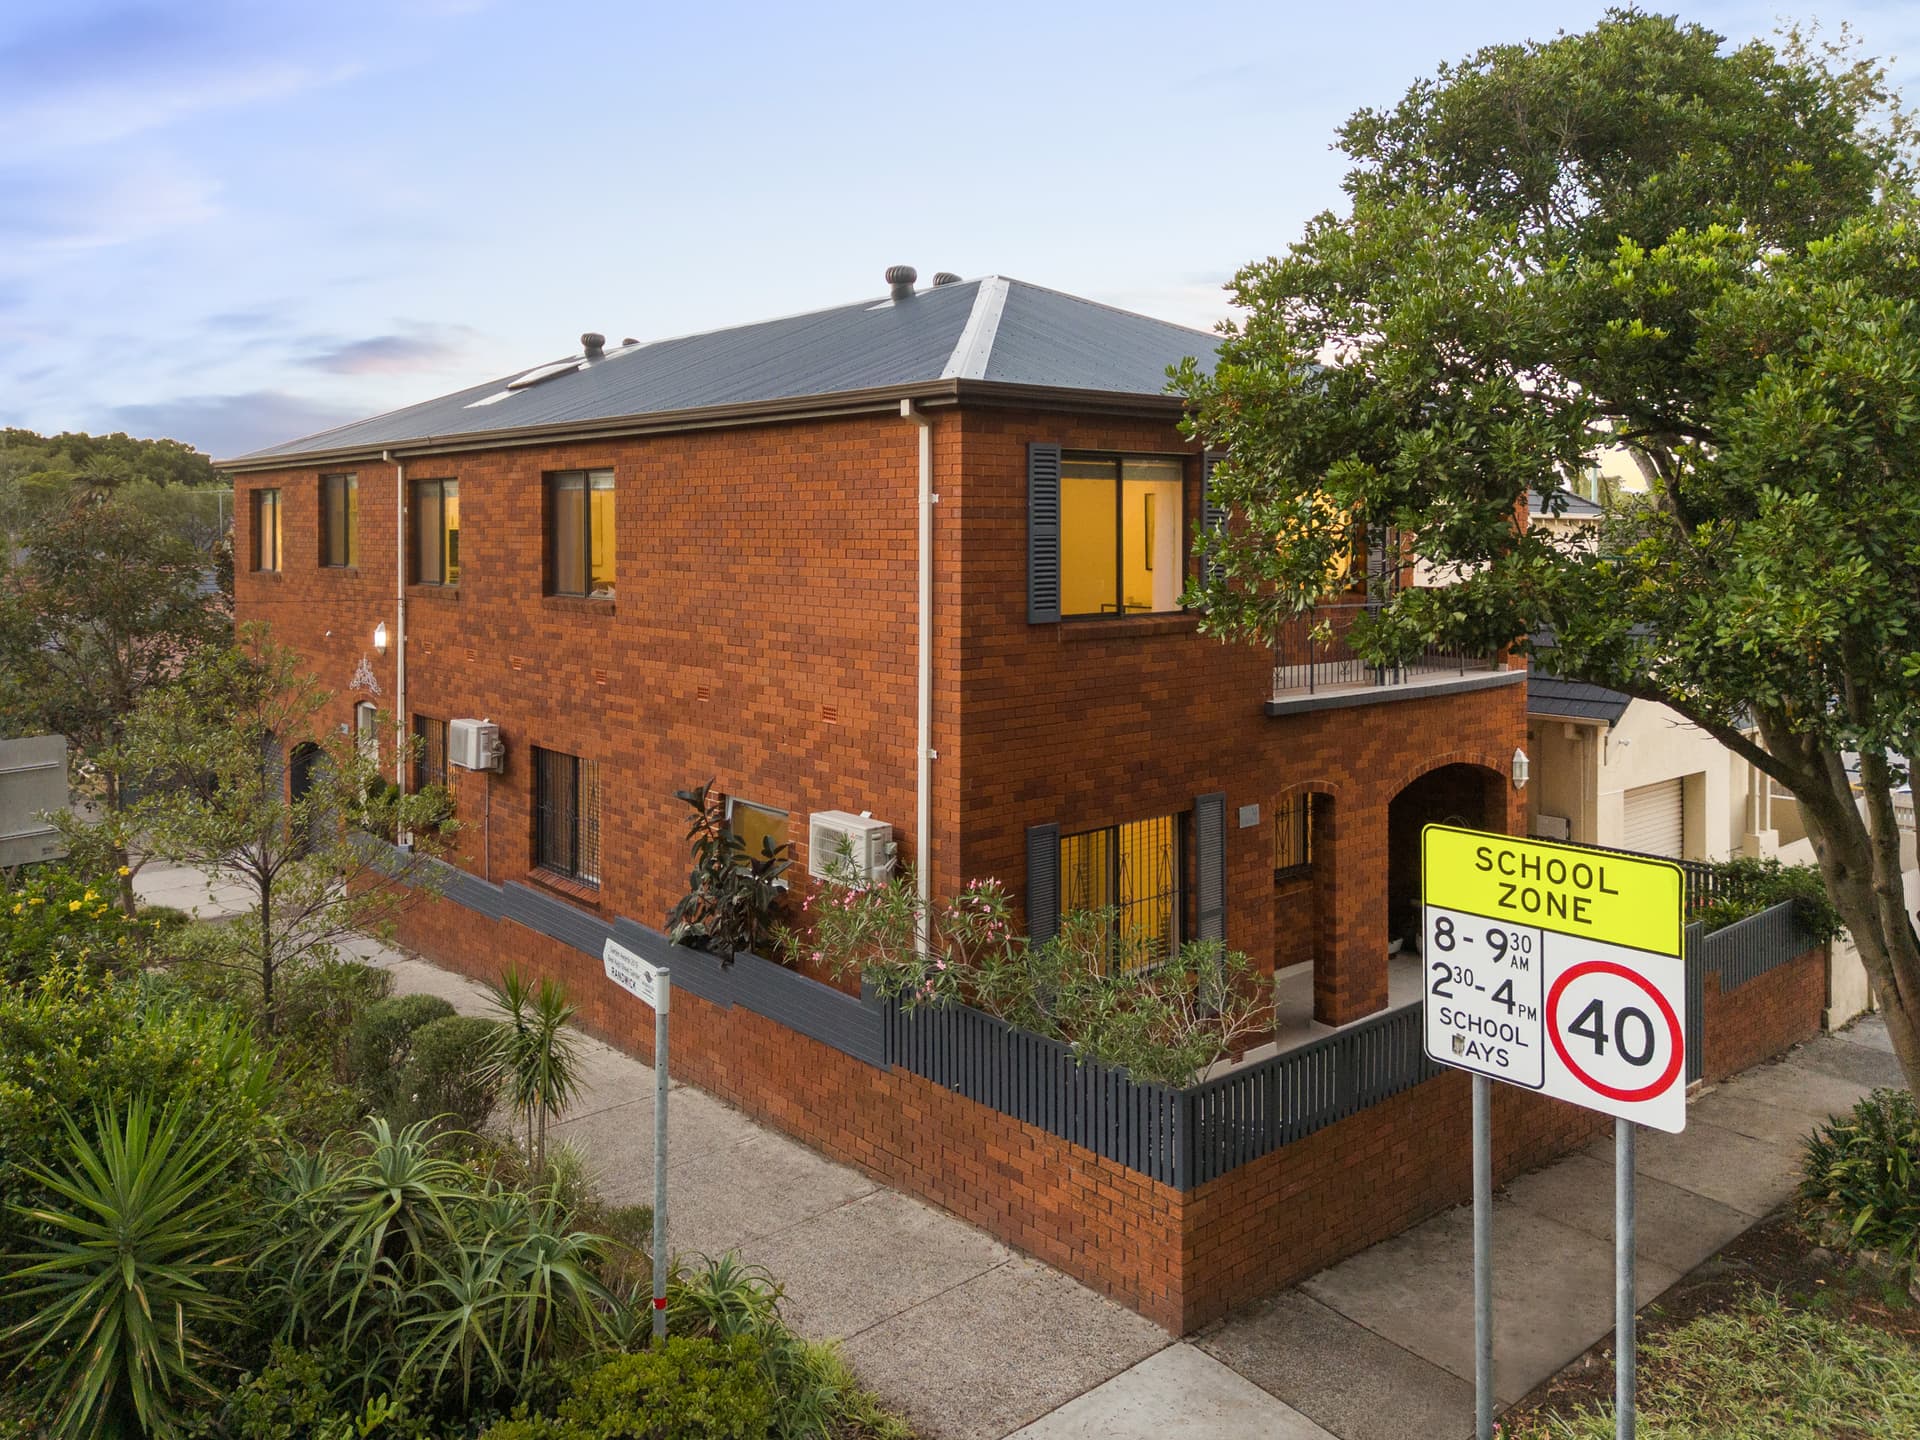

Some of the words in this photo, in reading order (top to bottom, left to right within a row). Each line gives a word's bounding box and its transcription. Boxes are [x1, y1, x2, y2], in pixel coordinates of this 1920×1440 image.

[1475, 846, 1619, 895] SCHOOL
[1498, 882, 1592, 925] ZONE
[1434, 916, 1456, 952] 8
[1510, 954, 1529, 971] AM
[1491, 978, 1516, 1015] 4
[1518, 1004, 1537, 1022] PM
[1440, 1007, 1529, 1047] SCHOOL
[1568, 998, 1656, 1067] 40
[1452, 1034, 1510, 1068] AYS
